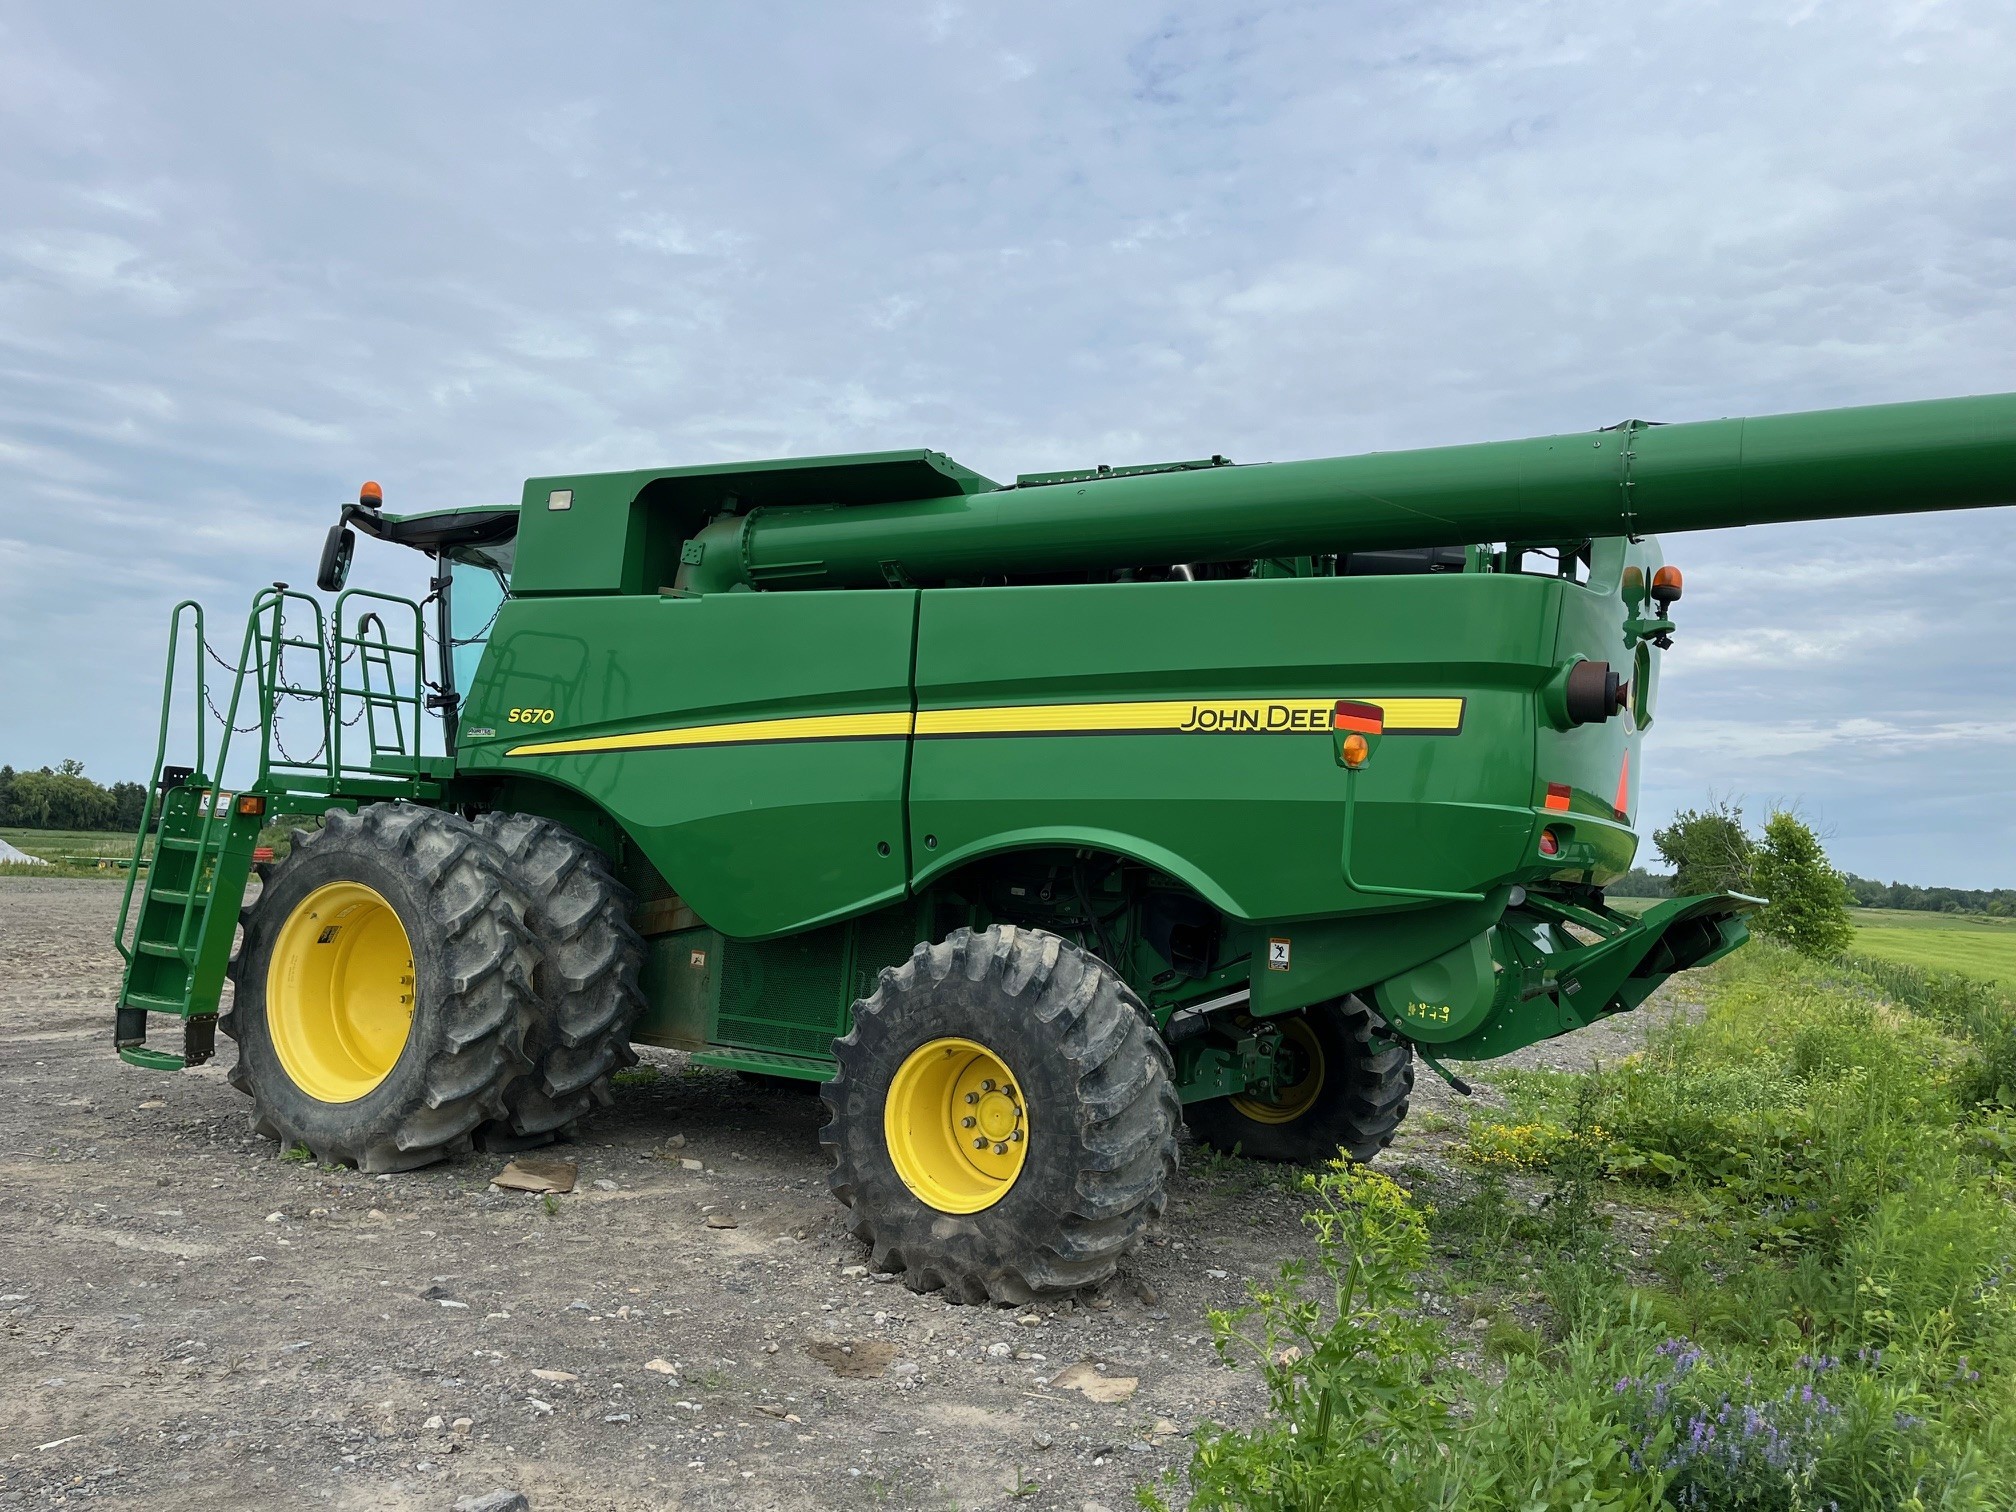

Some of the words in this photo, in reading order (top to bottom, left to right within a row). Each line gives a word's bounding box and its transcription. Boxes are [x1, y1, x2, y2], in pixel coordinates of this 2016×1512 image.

[507, 708, 555, 724] S670
[1181, 705, 1259, 728] JOHN
[1267, 705, 1334, 728] DEE
